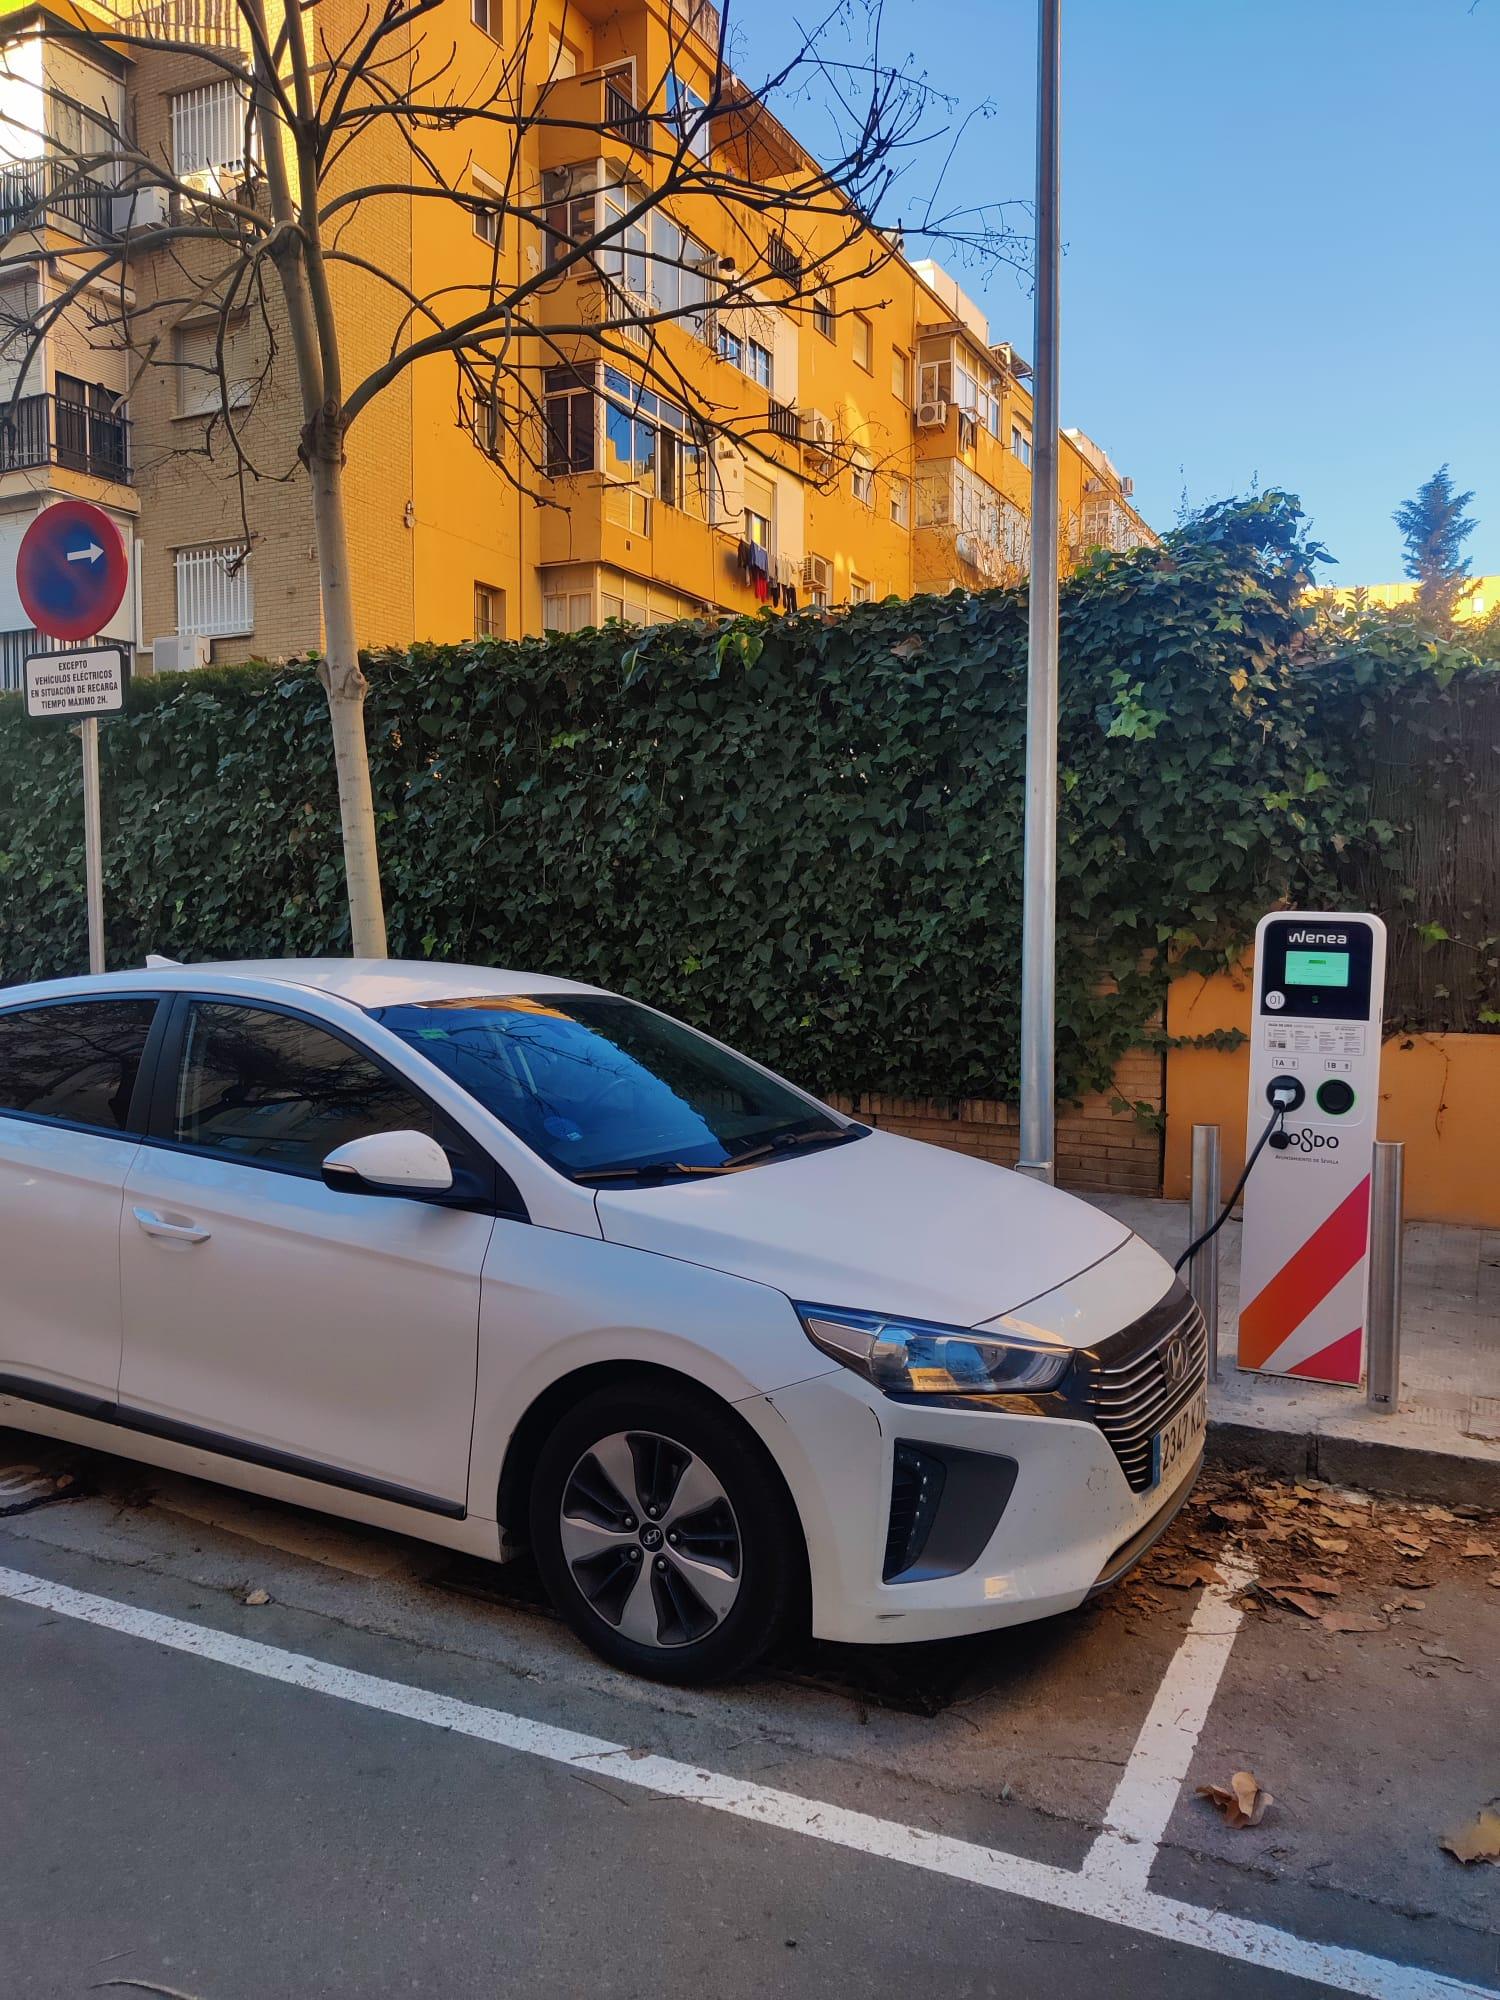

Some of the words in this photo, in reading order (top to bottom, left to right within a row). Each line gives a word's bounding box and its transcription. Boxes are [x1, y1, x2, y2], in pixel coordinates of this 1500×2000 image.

[58, 660, 88, 670] EXCEPTO
[31, 689, 40, 698] EN
[77, 685, 86, 694] DE
[87, 681, 118, 692] RECARGA
[42, 700, 66, 709] TIEMPO
[97, 695, 108, 705] 2H.
[1269, 995, 1281, 1005] 01
[1163, 1411, 1188, 1472] 2347
